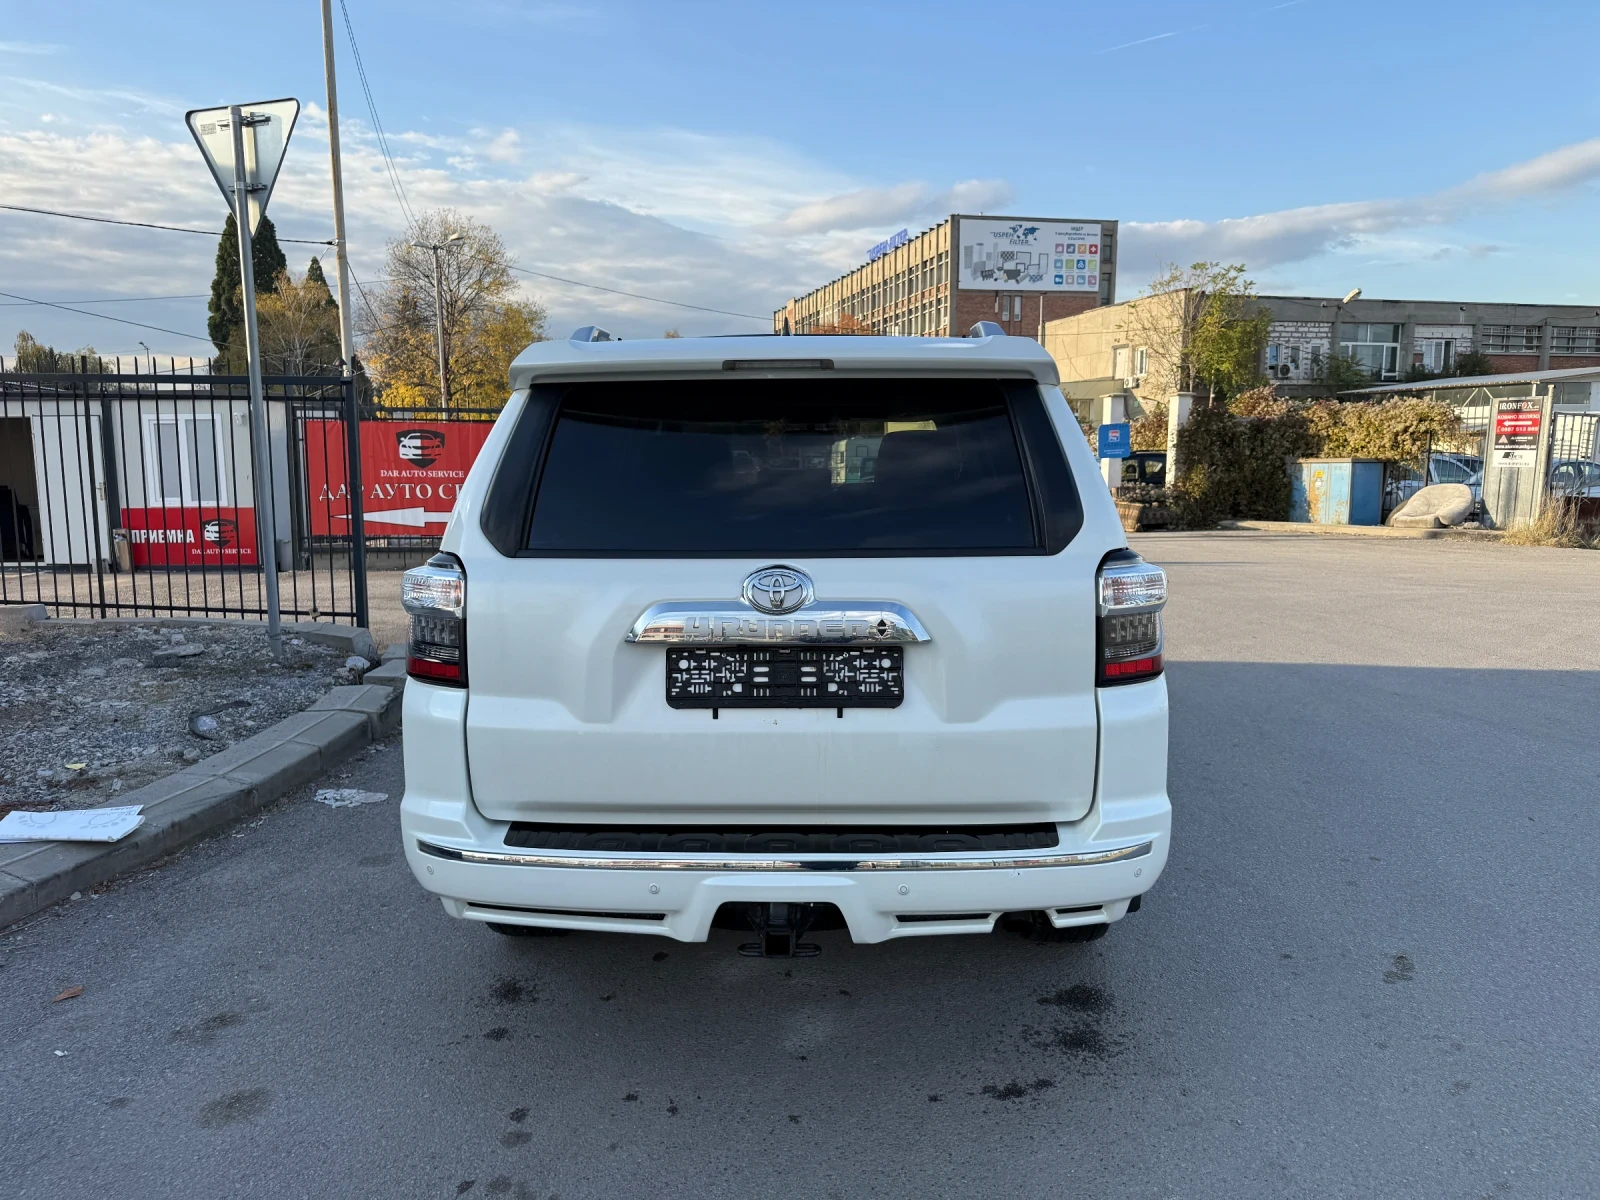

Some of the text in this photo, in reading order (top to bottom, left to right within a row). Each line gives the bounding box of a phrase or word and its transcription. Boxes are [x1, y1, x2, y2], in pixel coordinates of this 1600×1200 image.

[380, 469, 465, 478] DAR AUTO SERVICE
[370, 483, 433, 500] АУТО
[131, 529, 195, 544] ПРИЕМНА
[684, 616, 871, 640] 4RUNNER
